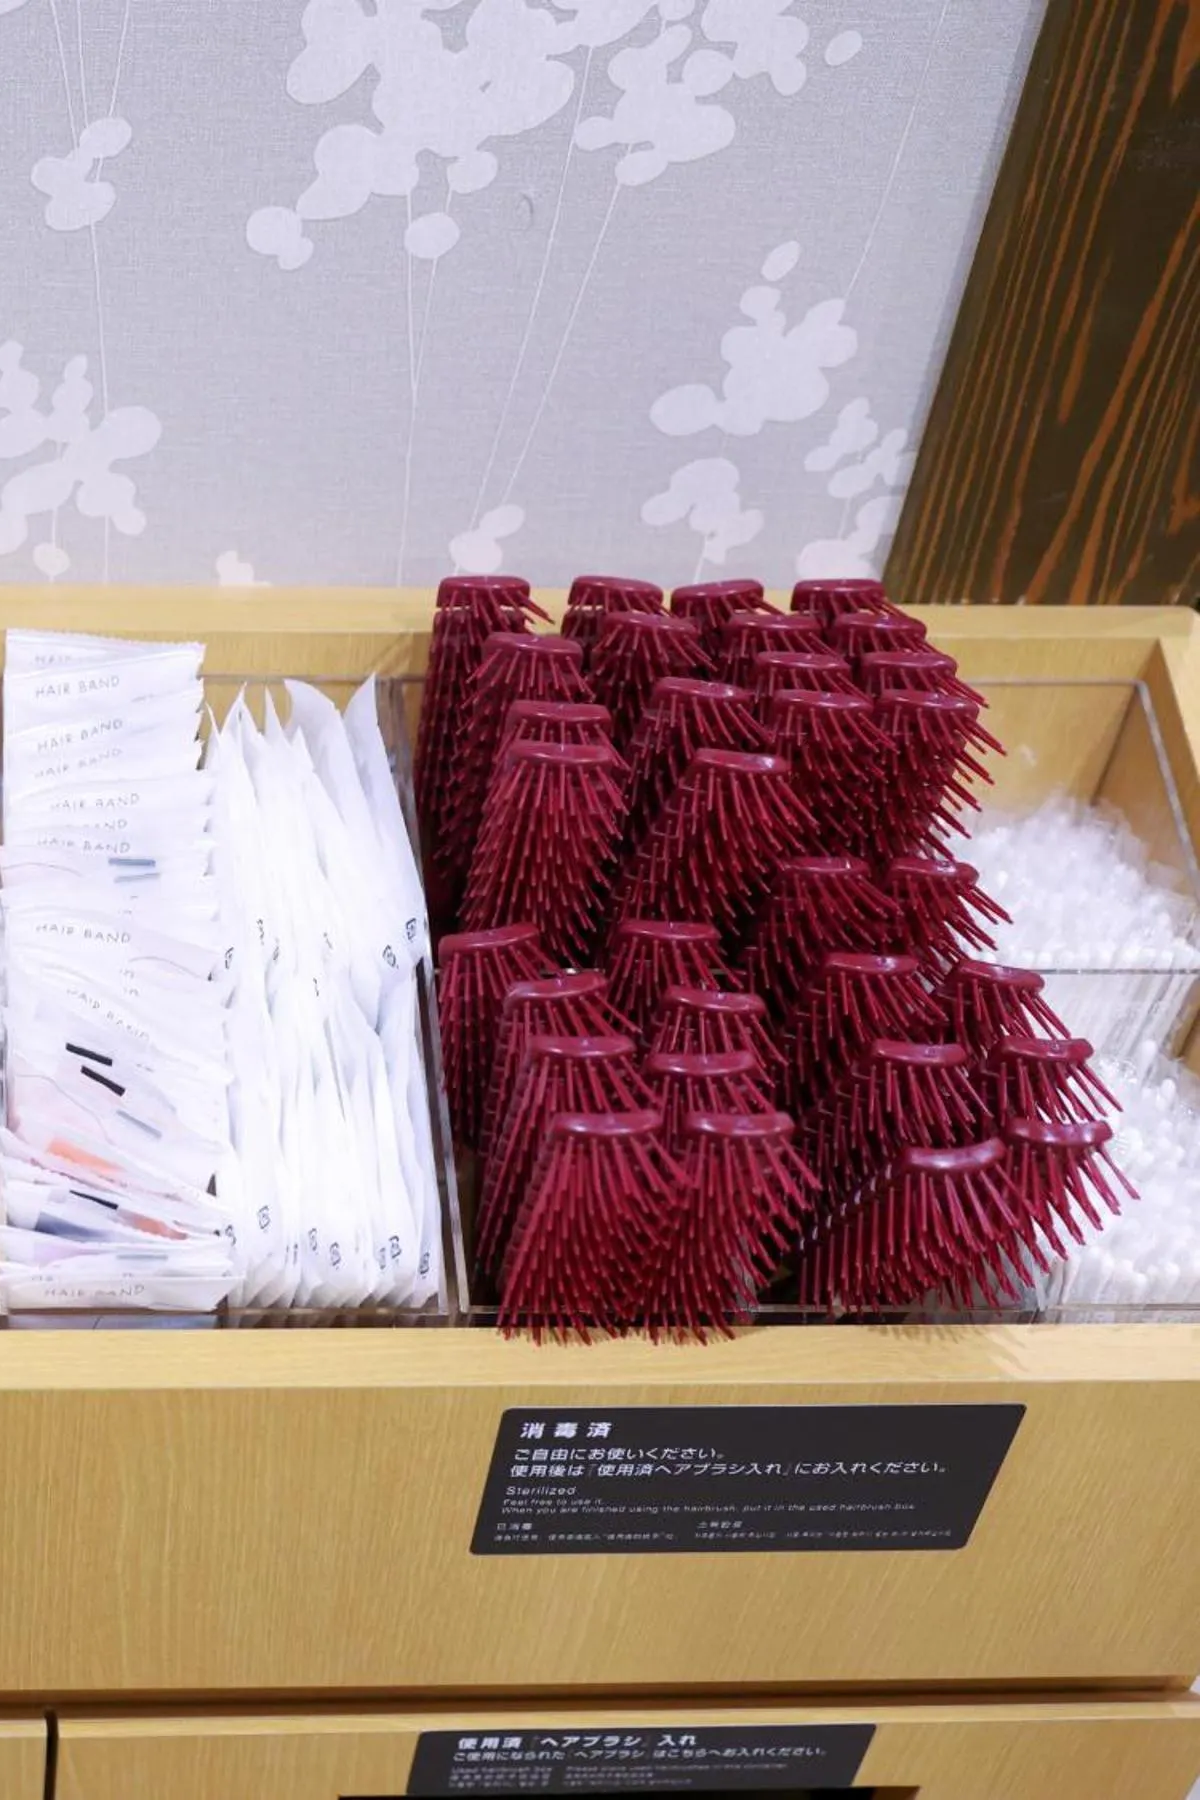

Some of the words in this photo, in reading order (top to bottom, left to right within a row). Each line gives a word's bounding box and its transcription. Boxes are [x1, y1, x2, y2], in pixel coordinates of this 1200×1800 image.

[36, 682, 71, 698] HAIR
[79, 675, 120, 693] BAND
[519, 1421, 613, 1440] 消毒済
[513, 1446, 726, 1462] ご自由にお使いください。
[505, 1485, 577, 1496] Sterilized
